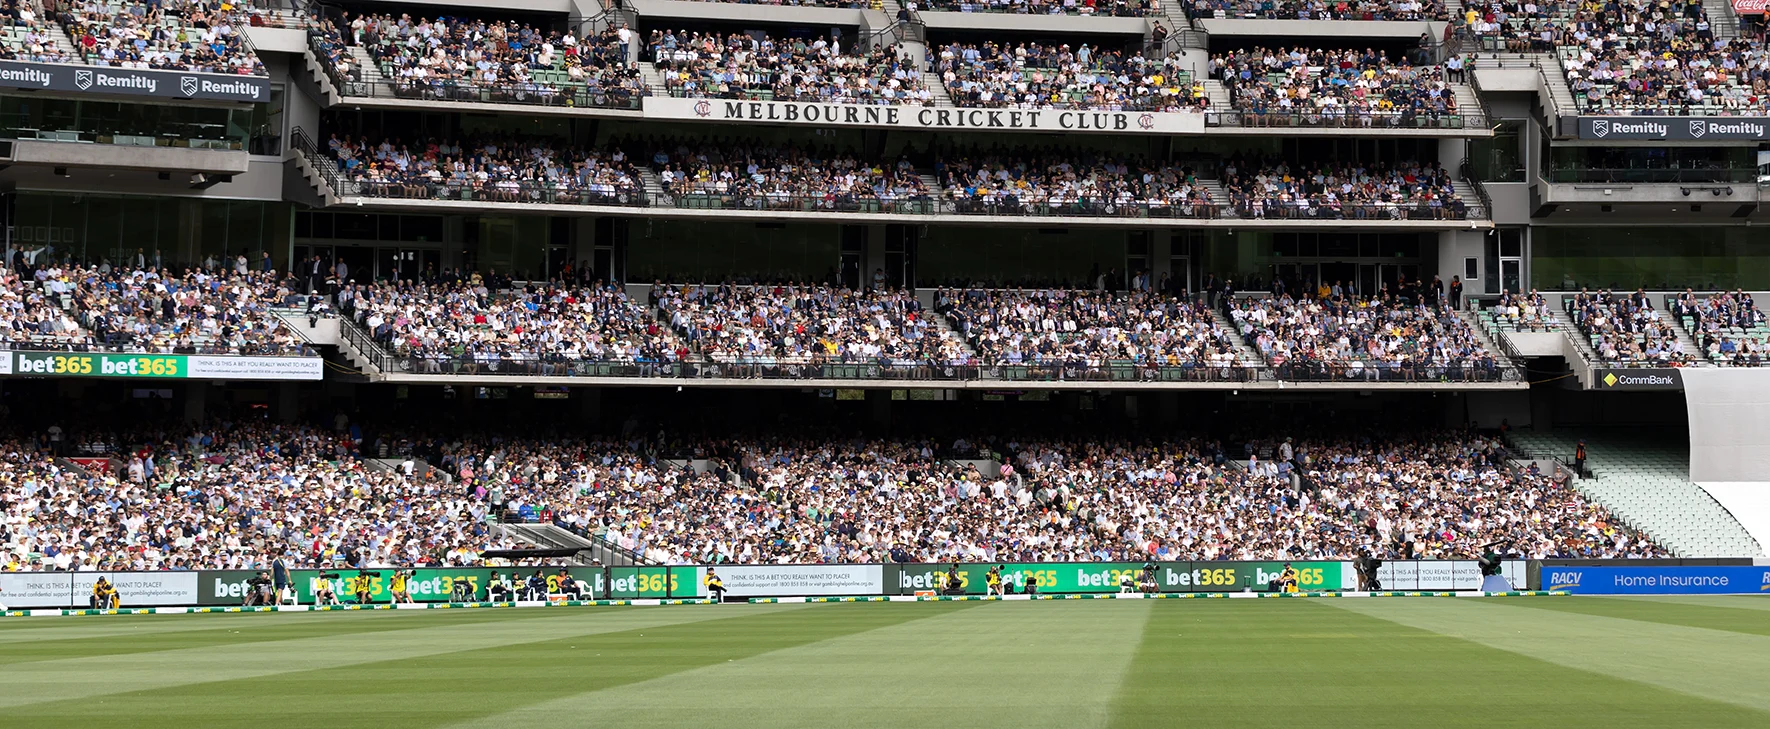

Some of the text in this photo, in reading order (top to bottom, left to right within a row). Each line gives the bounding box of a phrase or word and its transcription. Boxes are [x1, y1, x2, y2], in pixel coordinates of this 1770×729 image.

[0, 68, 50, 86] emitly
[96, 74, 156, 92] Remitly
[202, 80, 260, 98] Remitly
[724, 102, 1128, 130] MELBOURNE CRICKET CLUB
[1612, 122, 1667, 136] Remitly
[1710, 122, 1764, 136] Remitly
[19, 354, 92, 374] bet365
[102, 356, 177, 376] bet365
[1619, 375, 1673, 384] CommBank
[1166, 568, 1235, 586] bet365
[1551, 572, 1582, 584] RACV
[1614, 574, 1728, 586] Home Insurance
